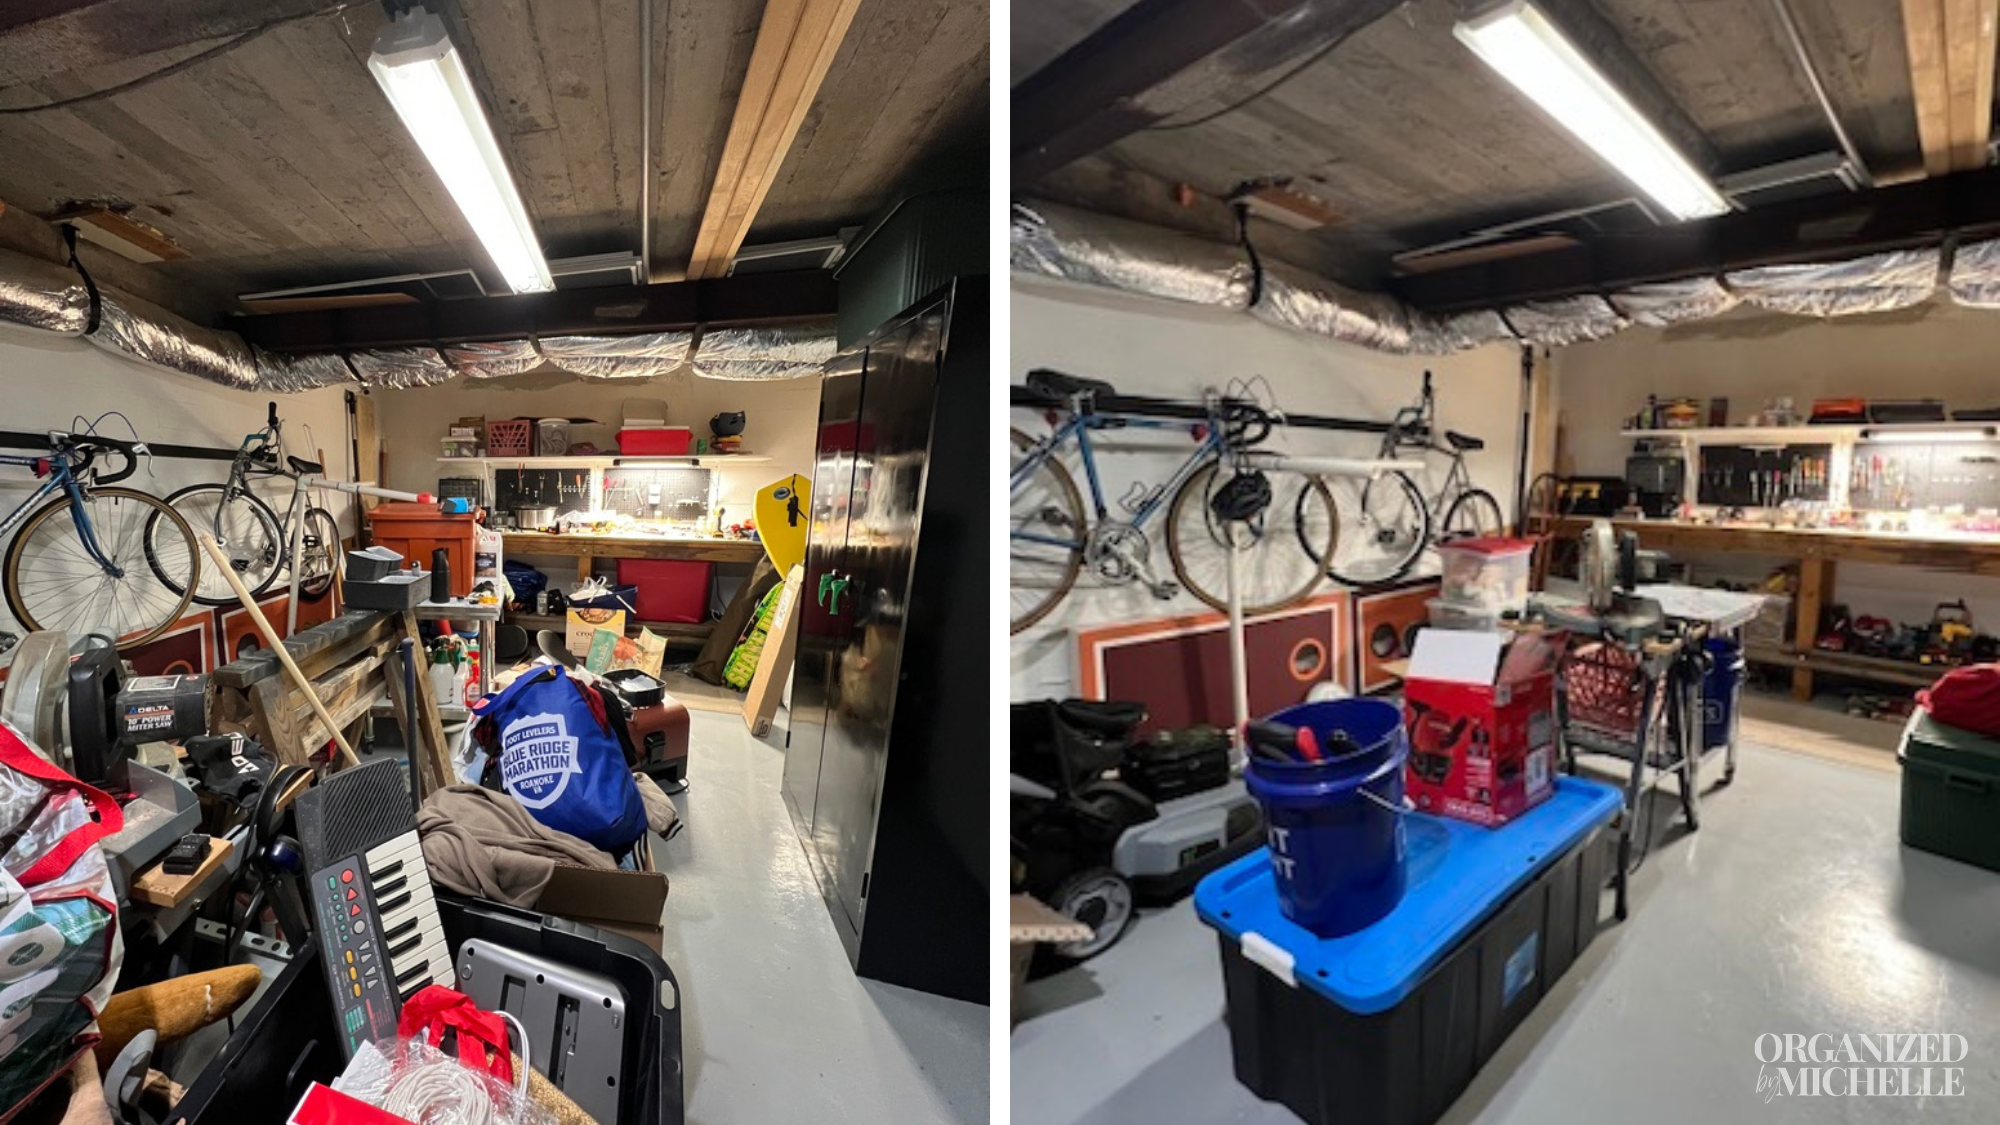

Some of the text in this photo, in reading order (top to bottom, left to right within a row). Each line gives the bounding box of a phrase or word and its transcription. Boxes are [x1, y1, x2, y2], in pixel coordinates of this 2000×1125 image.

[137, 704, 170, 713] DELTA
[142, 714, 172, 724] POWER
[127, 720, 173, 732] MITER SAW
[506, 726, 556, 747] FOOT LEVELERS
[503, 741, 571, 769] BLUE RIDGE
[504, 755, 570, 781] MARATHON
[520, 775, 555, 790] ROANOKE
[533, 786, 543, 795] VA
